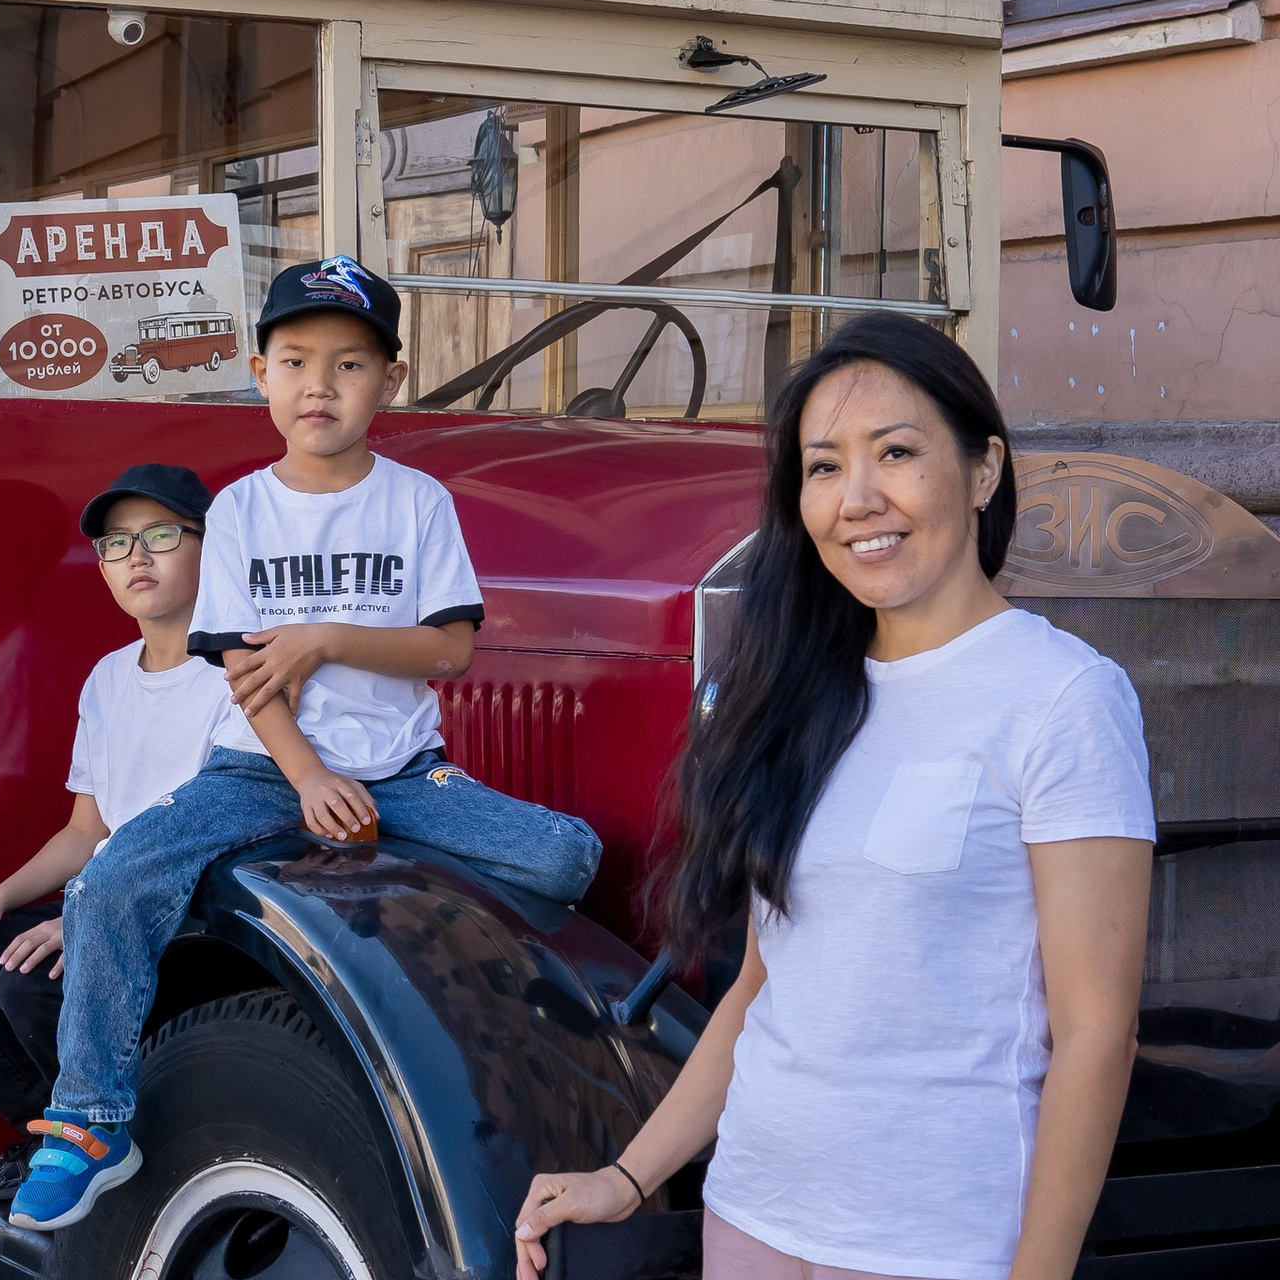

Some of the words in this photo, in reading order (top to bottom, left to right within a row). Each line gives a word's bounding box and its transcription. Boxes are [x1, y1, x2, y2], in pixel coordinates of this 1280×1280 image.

[17, 220, 206, 263] АРЕНДА
[23, 280, 205, 305] РЕТРО-АВТОБУСА
[26, 361, 82, 380] рублей
[1010, 485, 1193, 569] ЗИС
[249, 552, 404, 599] ATHLETIC
[269, 608, 296, 616] BOLD,
[298, 606, 309, 614] BE
[311, 605, 340, 613] BRAVE,
[342, 603, 353, 611] BE
[355, 604, 390, 613] ACTIVE!
